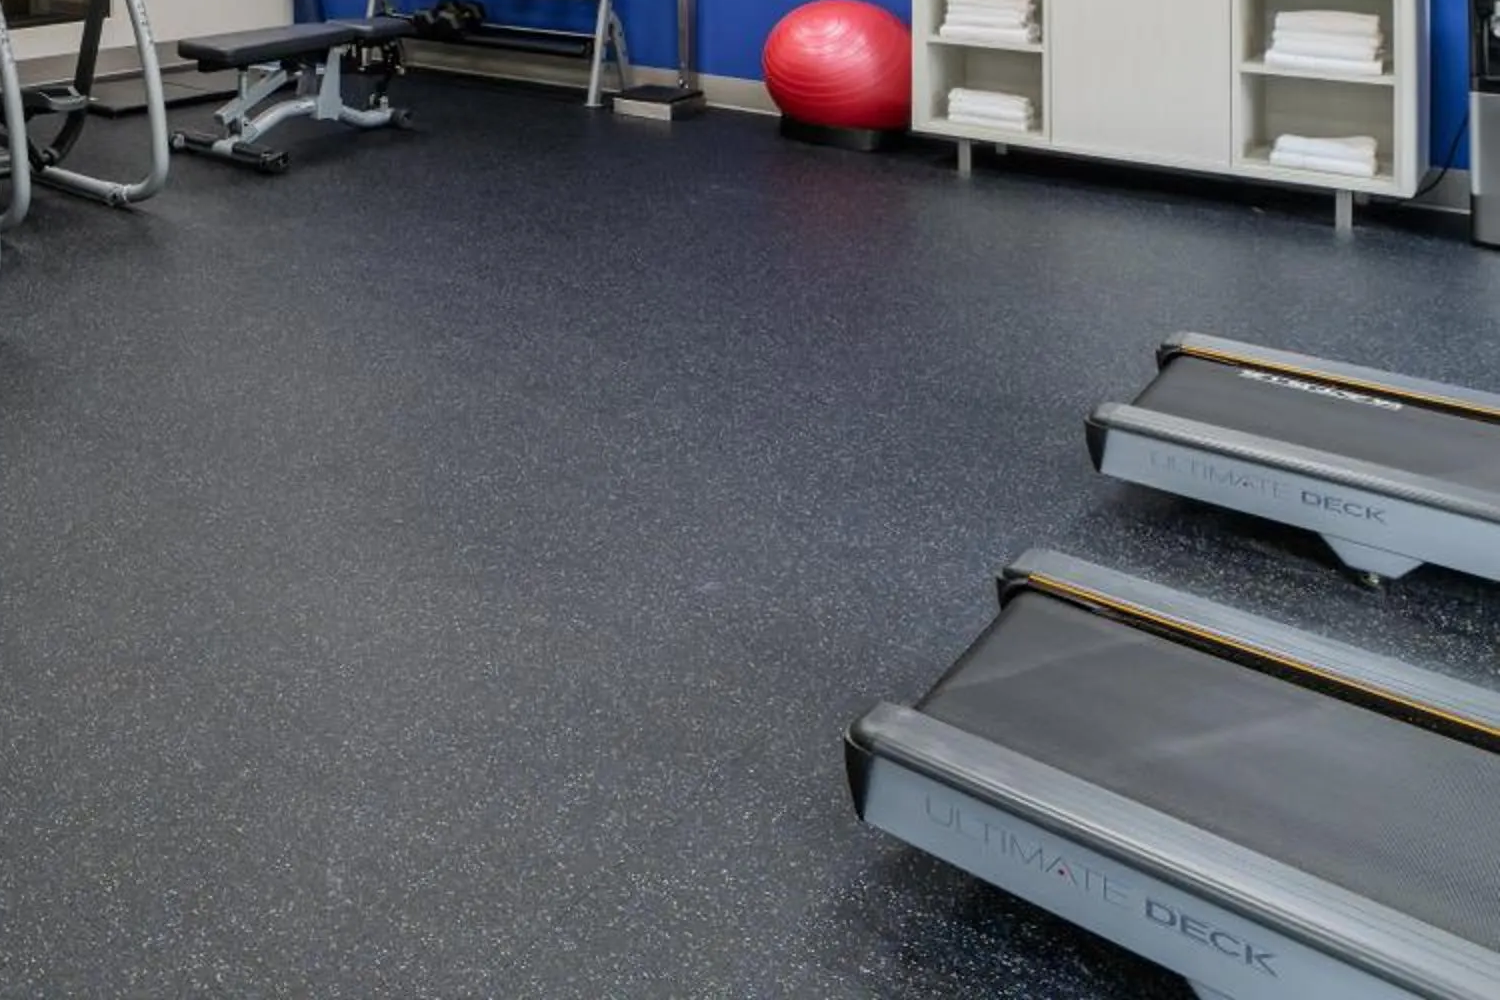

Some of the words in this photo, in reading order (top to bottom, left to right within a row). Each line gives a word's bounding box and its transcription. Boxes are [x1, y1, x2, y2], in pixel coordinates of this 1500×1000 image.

[1301, 490, 1388, 527] DECK
[924, 797, 1132, 906] ULTIMATE
[1145, 896, 1278, 979] DECK
